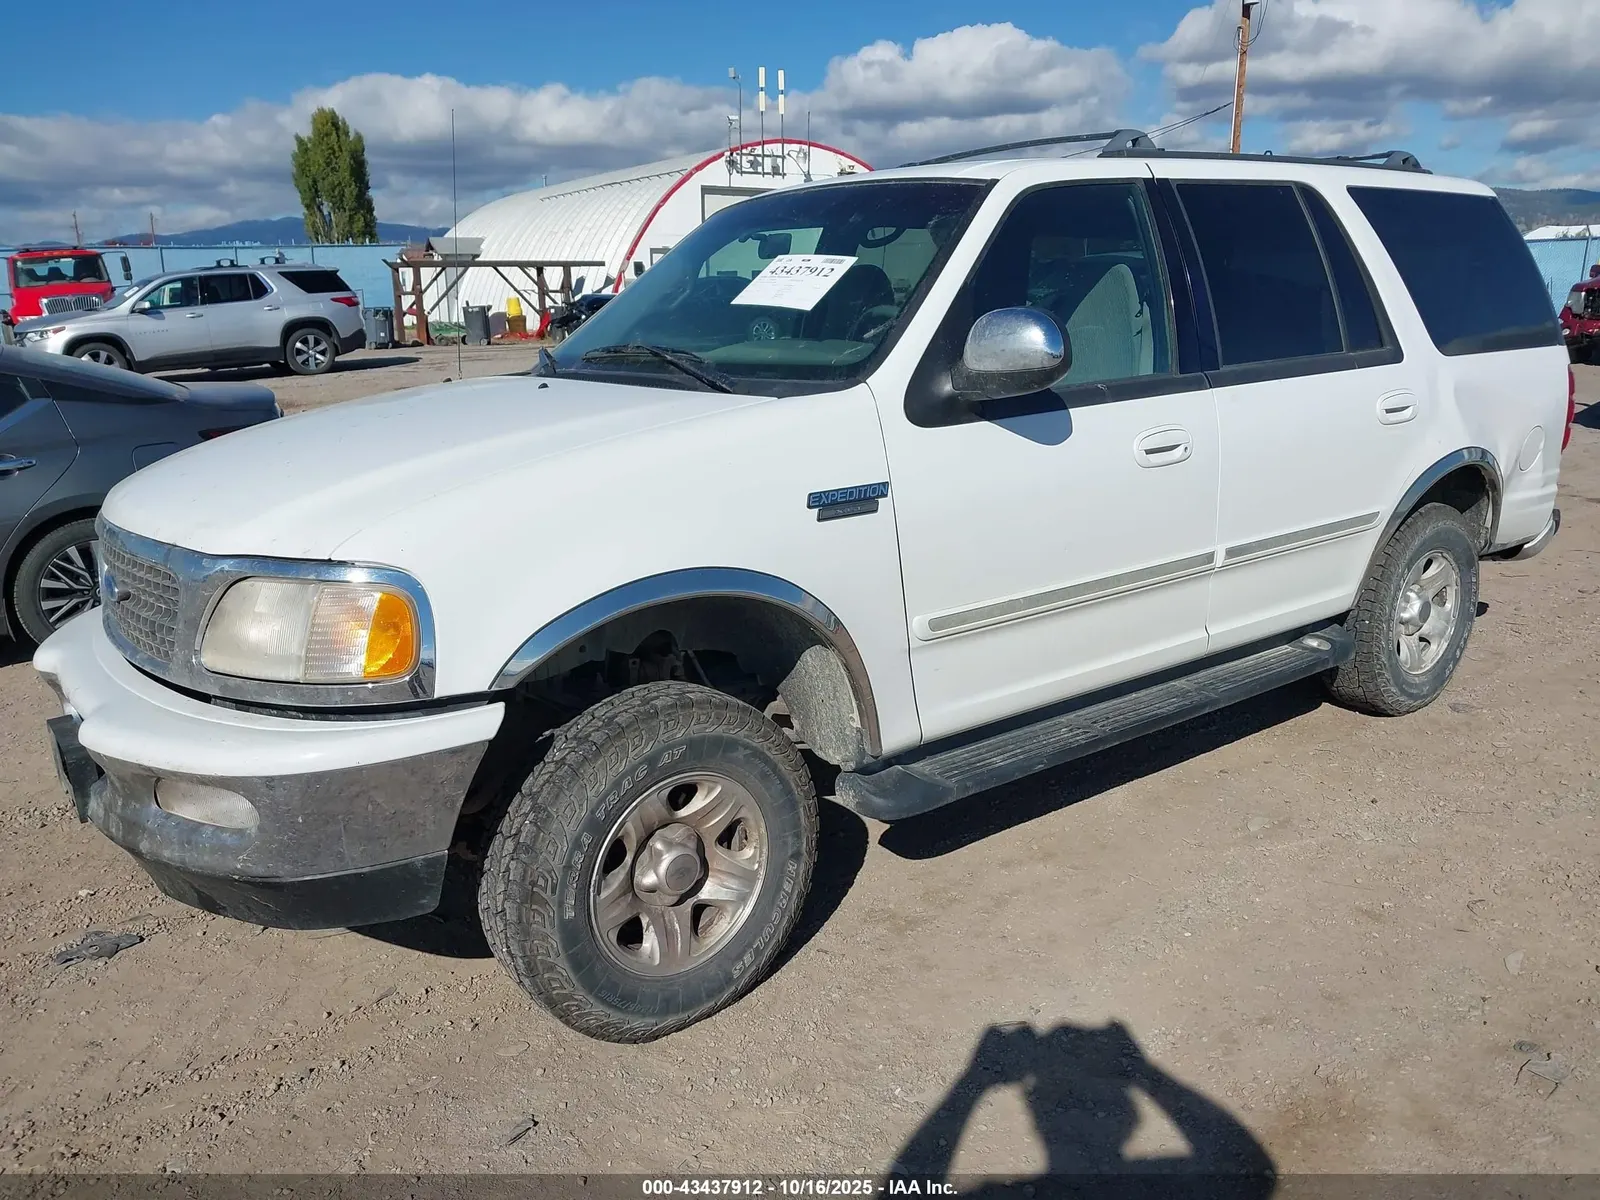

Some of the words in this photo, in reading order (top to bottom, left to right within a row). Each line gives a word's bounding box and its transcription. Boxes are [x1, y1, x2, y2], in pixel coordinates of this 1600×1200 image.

[769, 265, 835, 278] 43437912
[809, 483, 889, 507] EXPEDITION
[563, 832, 593, 920] TERRA
[595, 764, 648, 821] TRAC
[658, 745, 687, 768] AT
[731, 860, 798, 979] HERCULES
